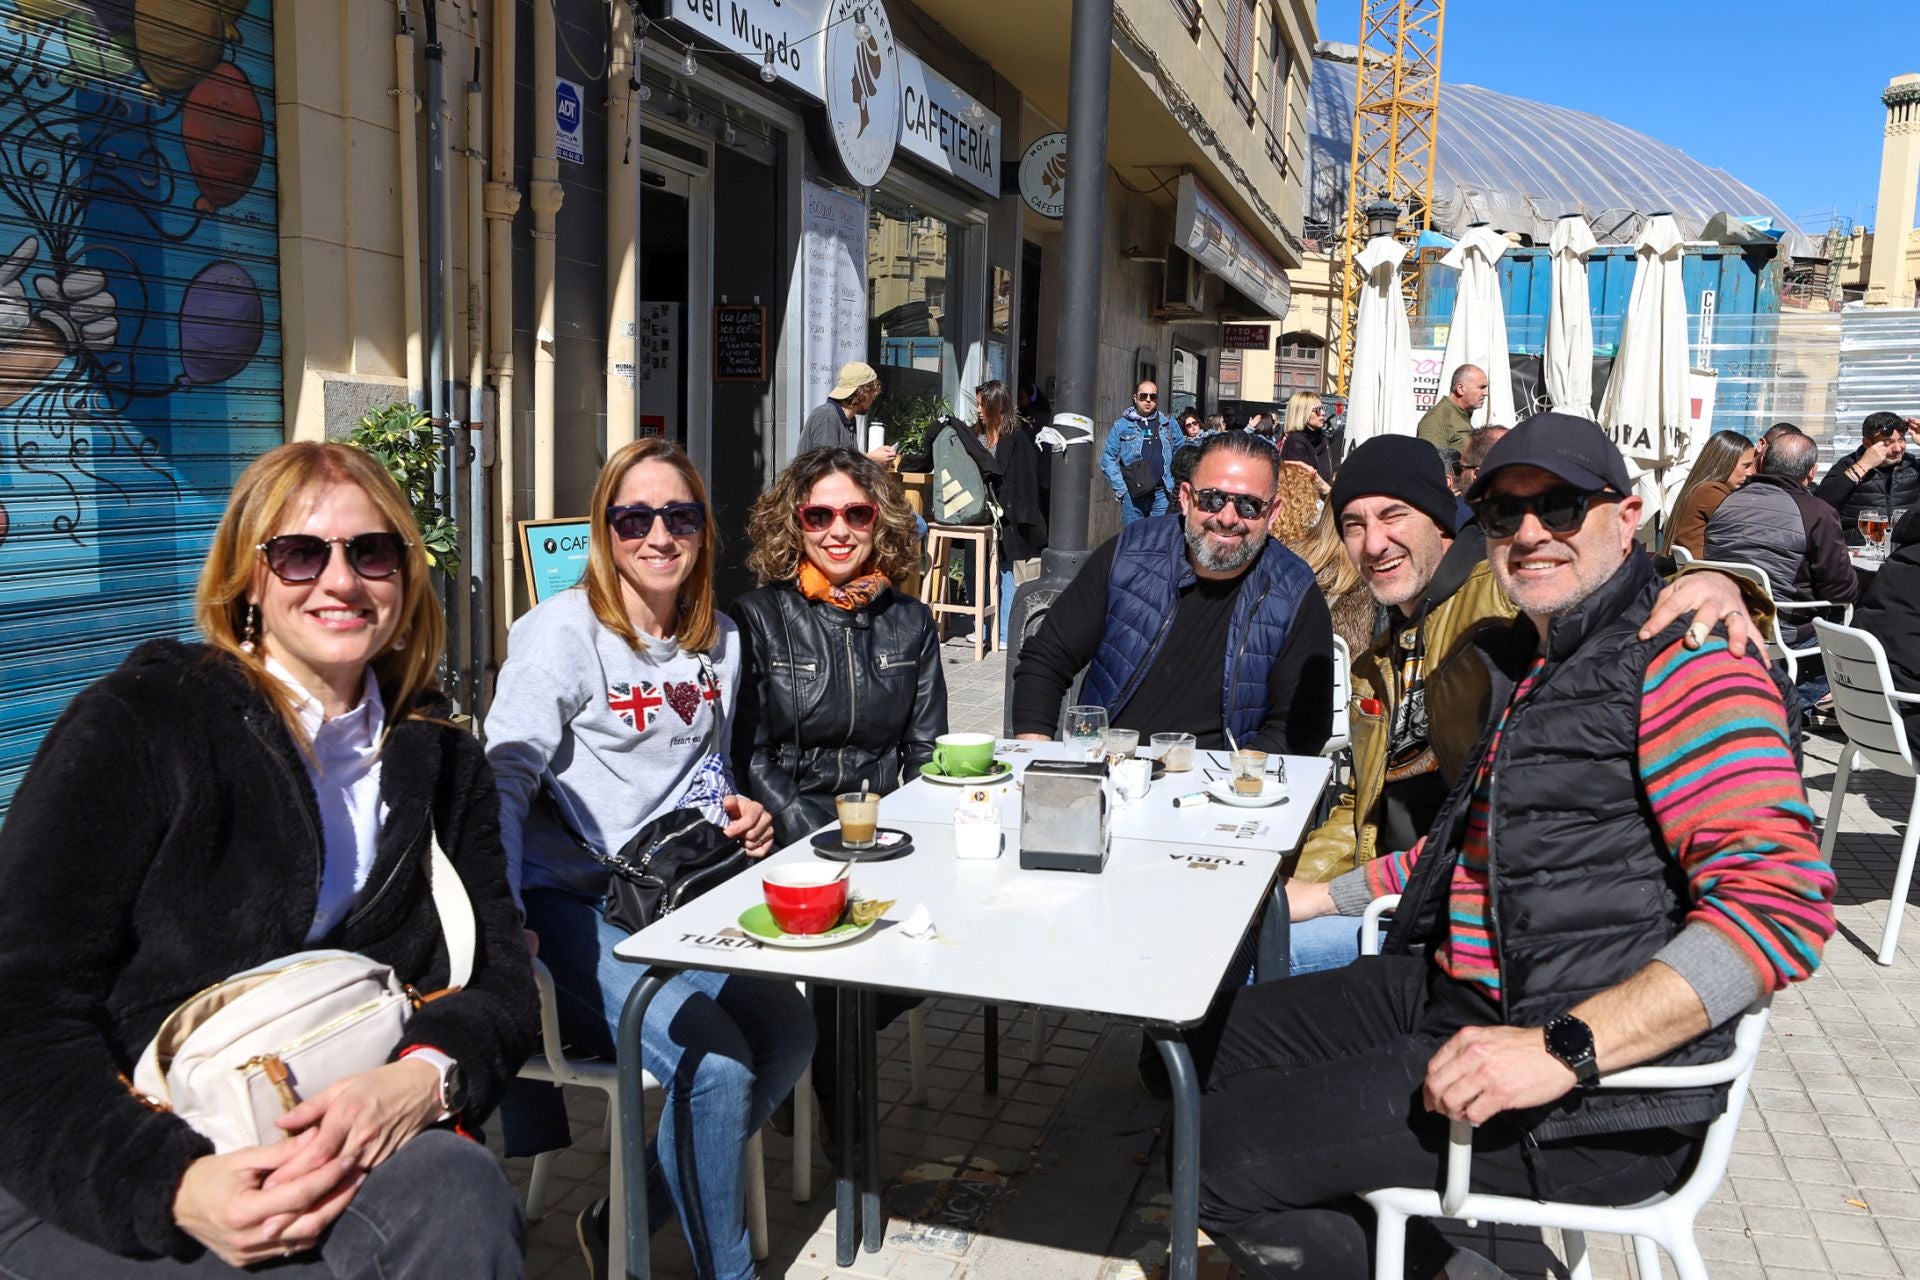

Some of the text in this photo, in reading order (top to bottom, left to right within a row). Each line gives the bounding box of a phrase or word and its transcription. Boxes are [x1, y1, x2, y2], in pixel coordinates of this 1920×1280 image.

[731, 1, 801, 72] Mundo
[558, 99, 576, 118] ADT
[904, 85, 993, 178] CAFETERÍA
[1029, 138, 1056, 158] MORA
[560, 536, 590, 552] CAF
[1168, 853, 1248, 867] TURIA
